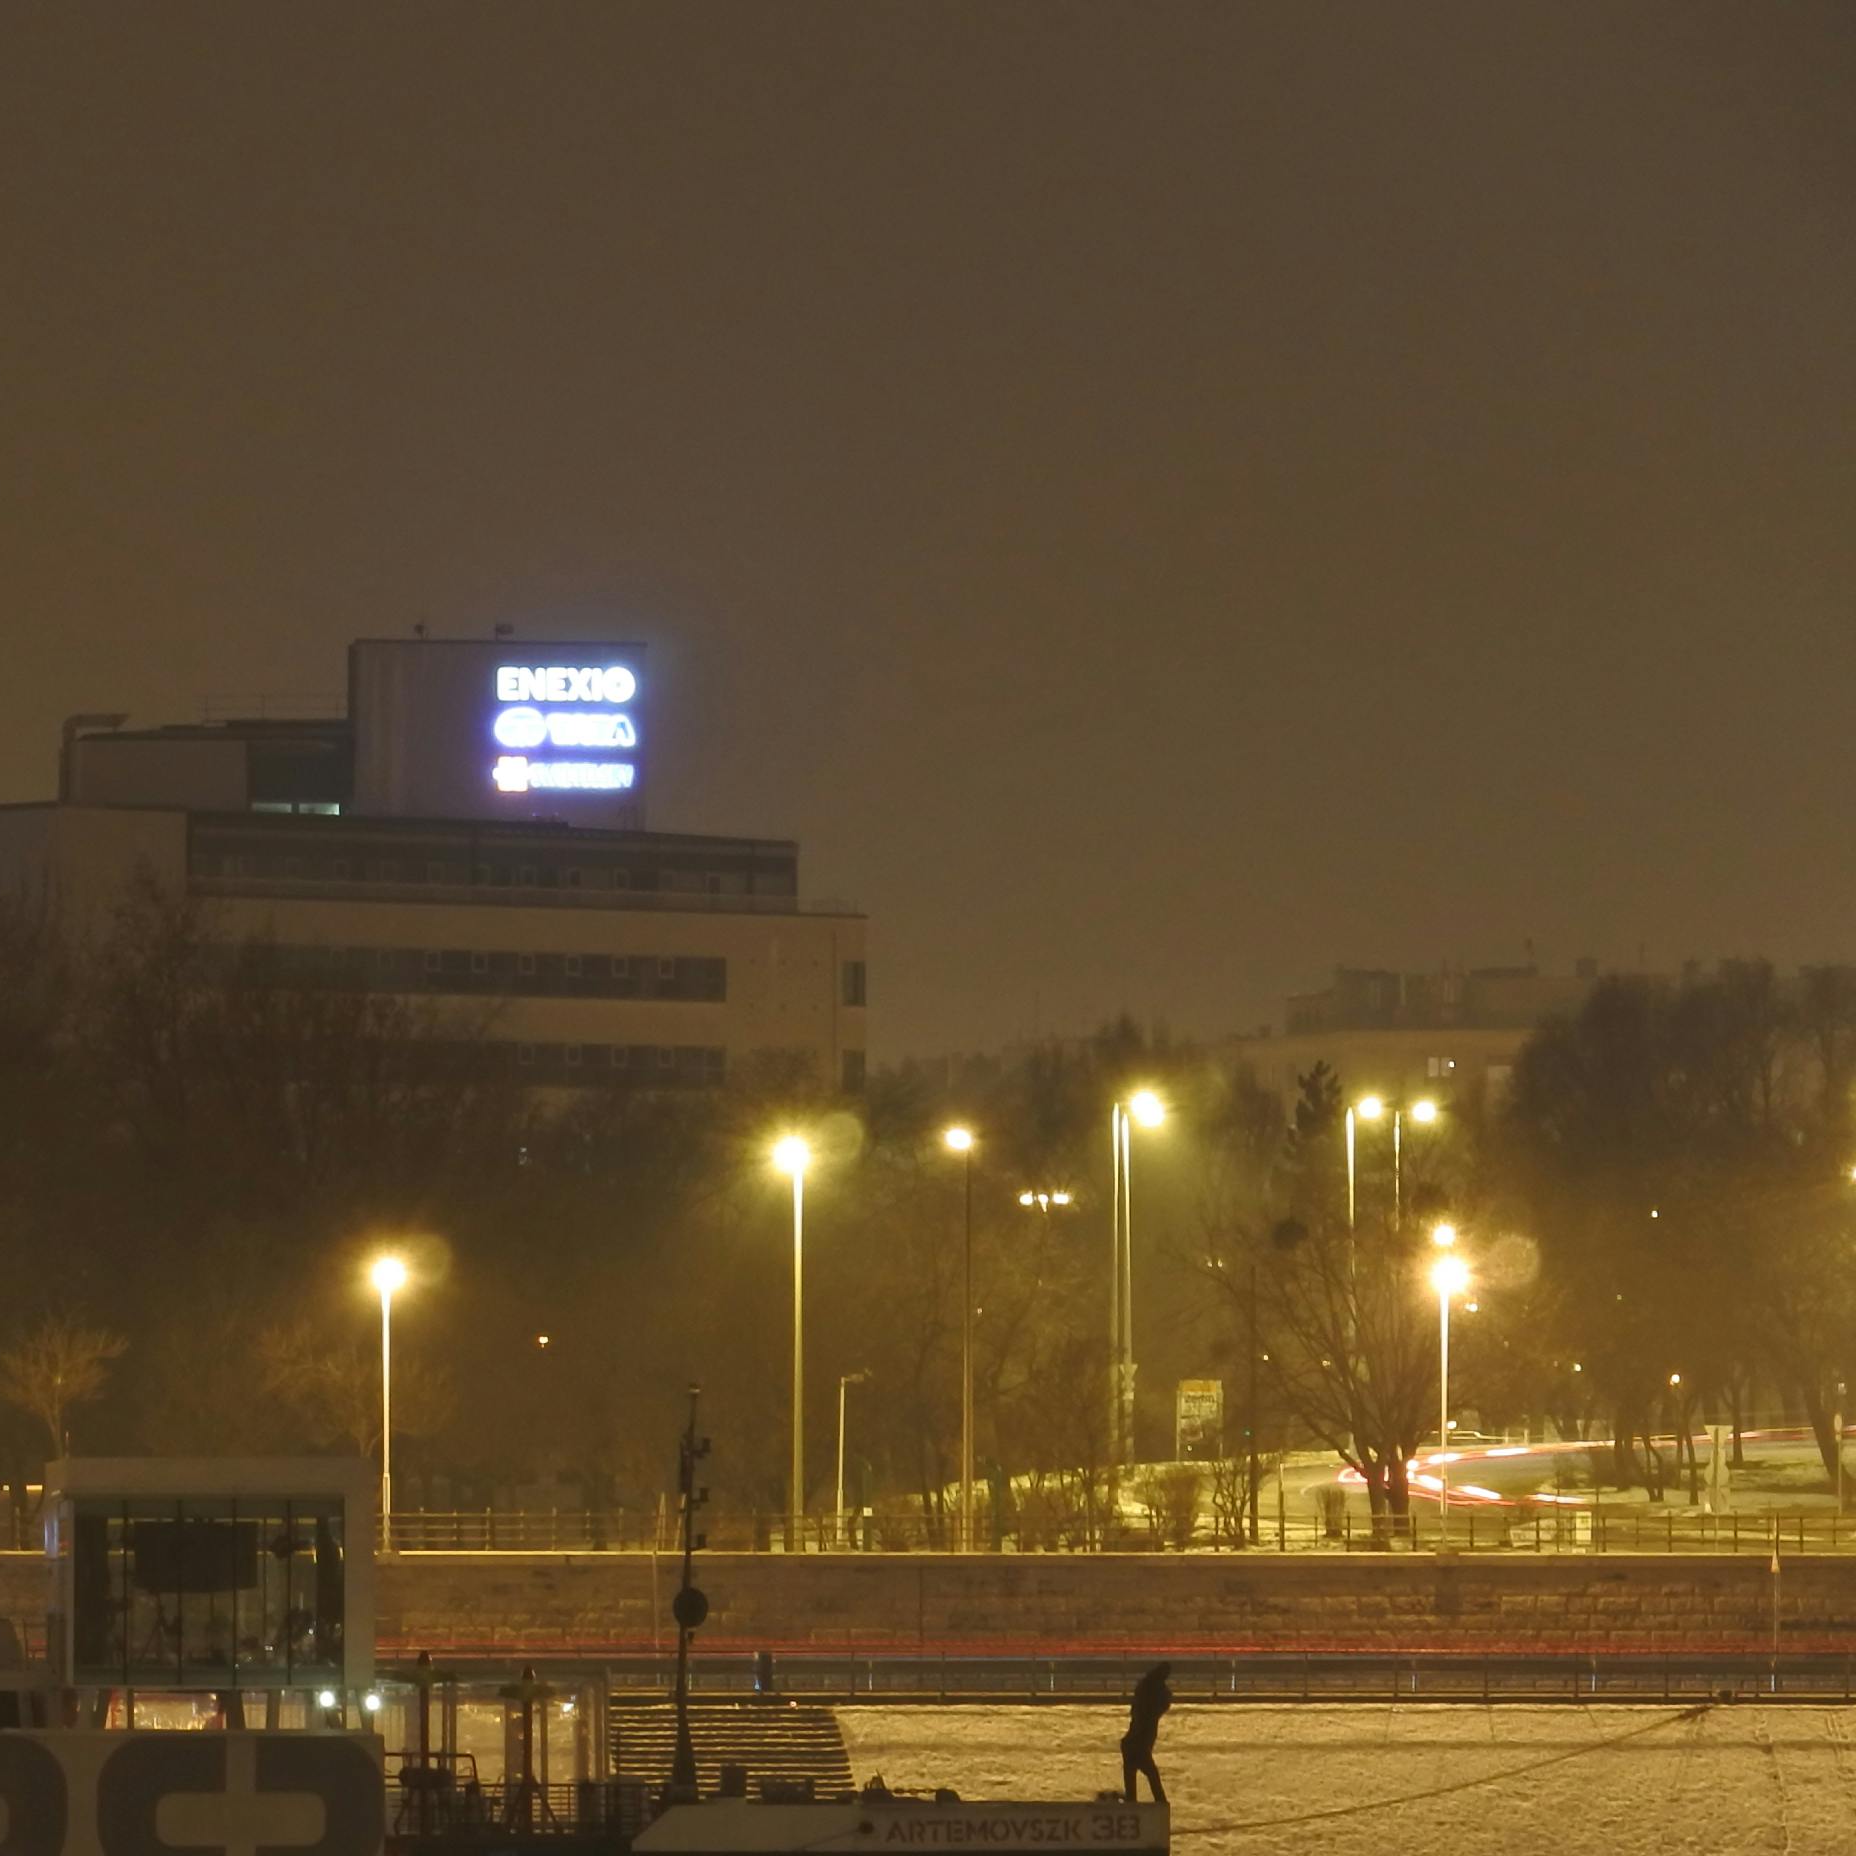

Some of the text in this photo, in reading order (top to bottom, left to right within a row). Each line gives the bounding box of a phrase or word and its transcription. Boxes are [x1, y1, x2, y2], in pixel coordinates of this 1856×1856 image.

[497, 666, 636, 703] ENEXIO
[885, 1814, 1142, 1844] ARTEMOVSZK 38
